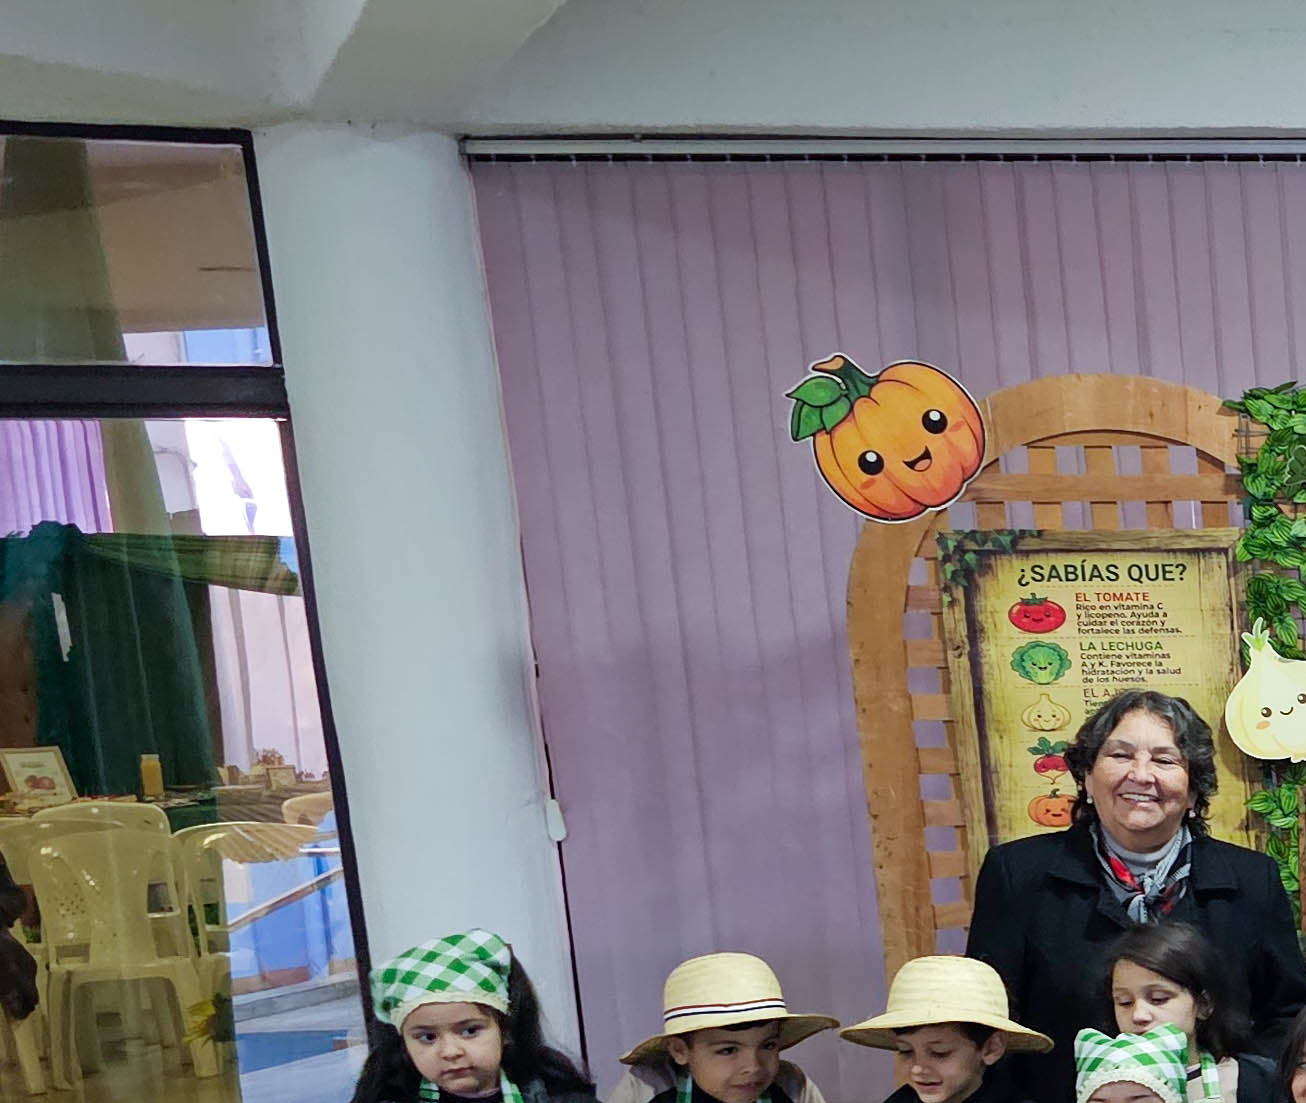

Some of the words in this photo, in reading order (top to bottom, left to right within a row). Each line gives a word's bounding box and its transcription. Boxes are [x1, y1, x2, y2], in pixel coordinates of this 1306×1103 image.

[1017, 559, 1120, 588] ¿SABÍAS
[1127, 562, 1187, 584] QUE?
[1075, 592, 1091, 603] EL
[1095, 591, 1151, 602] TOMATE
[1113, 602, 1155, 611] vitamina
[1079, 641, 1096, 651] LA
[1100, 640, 1164, 651] LECHUGA
[1083, 688, 1098, 698] EL
